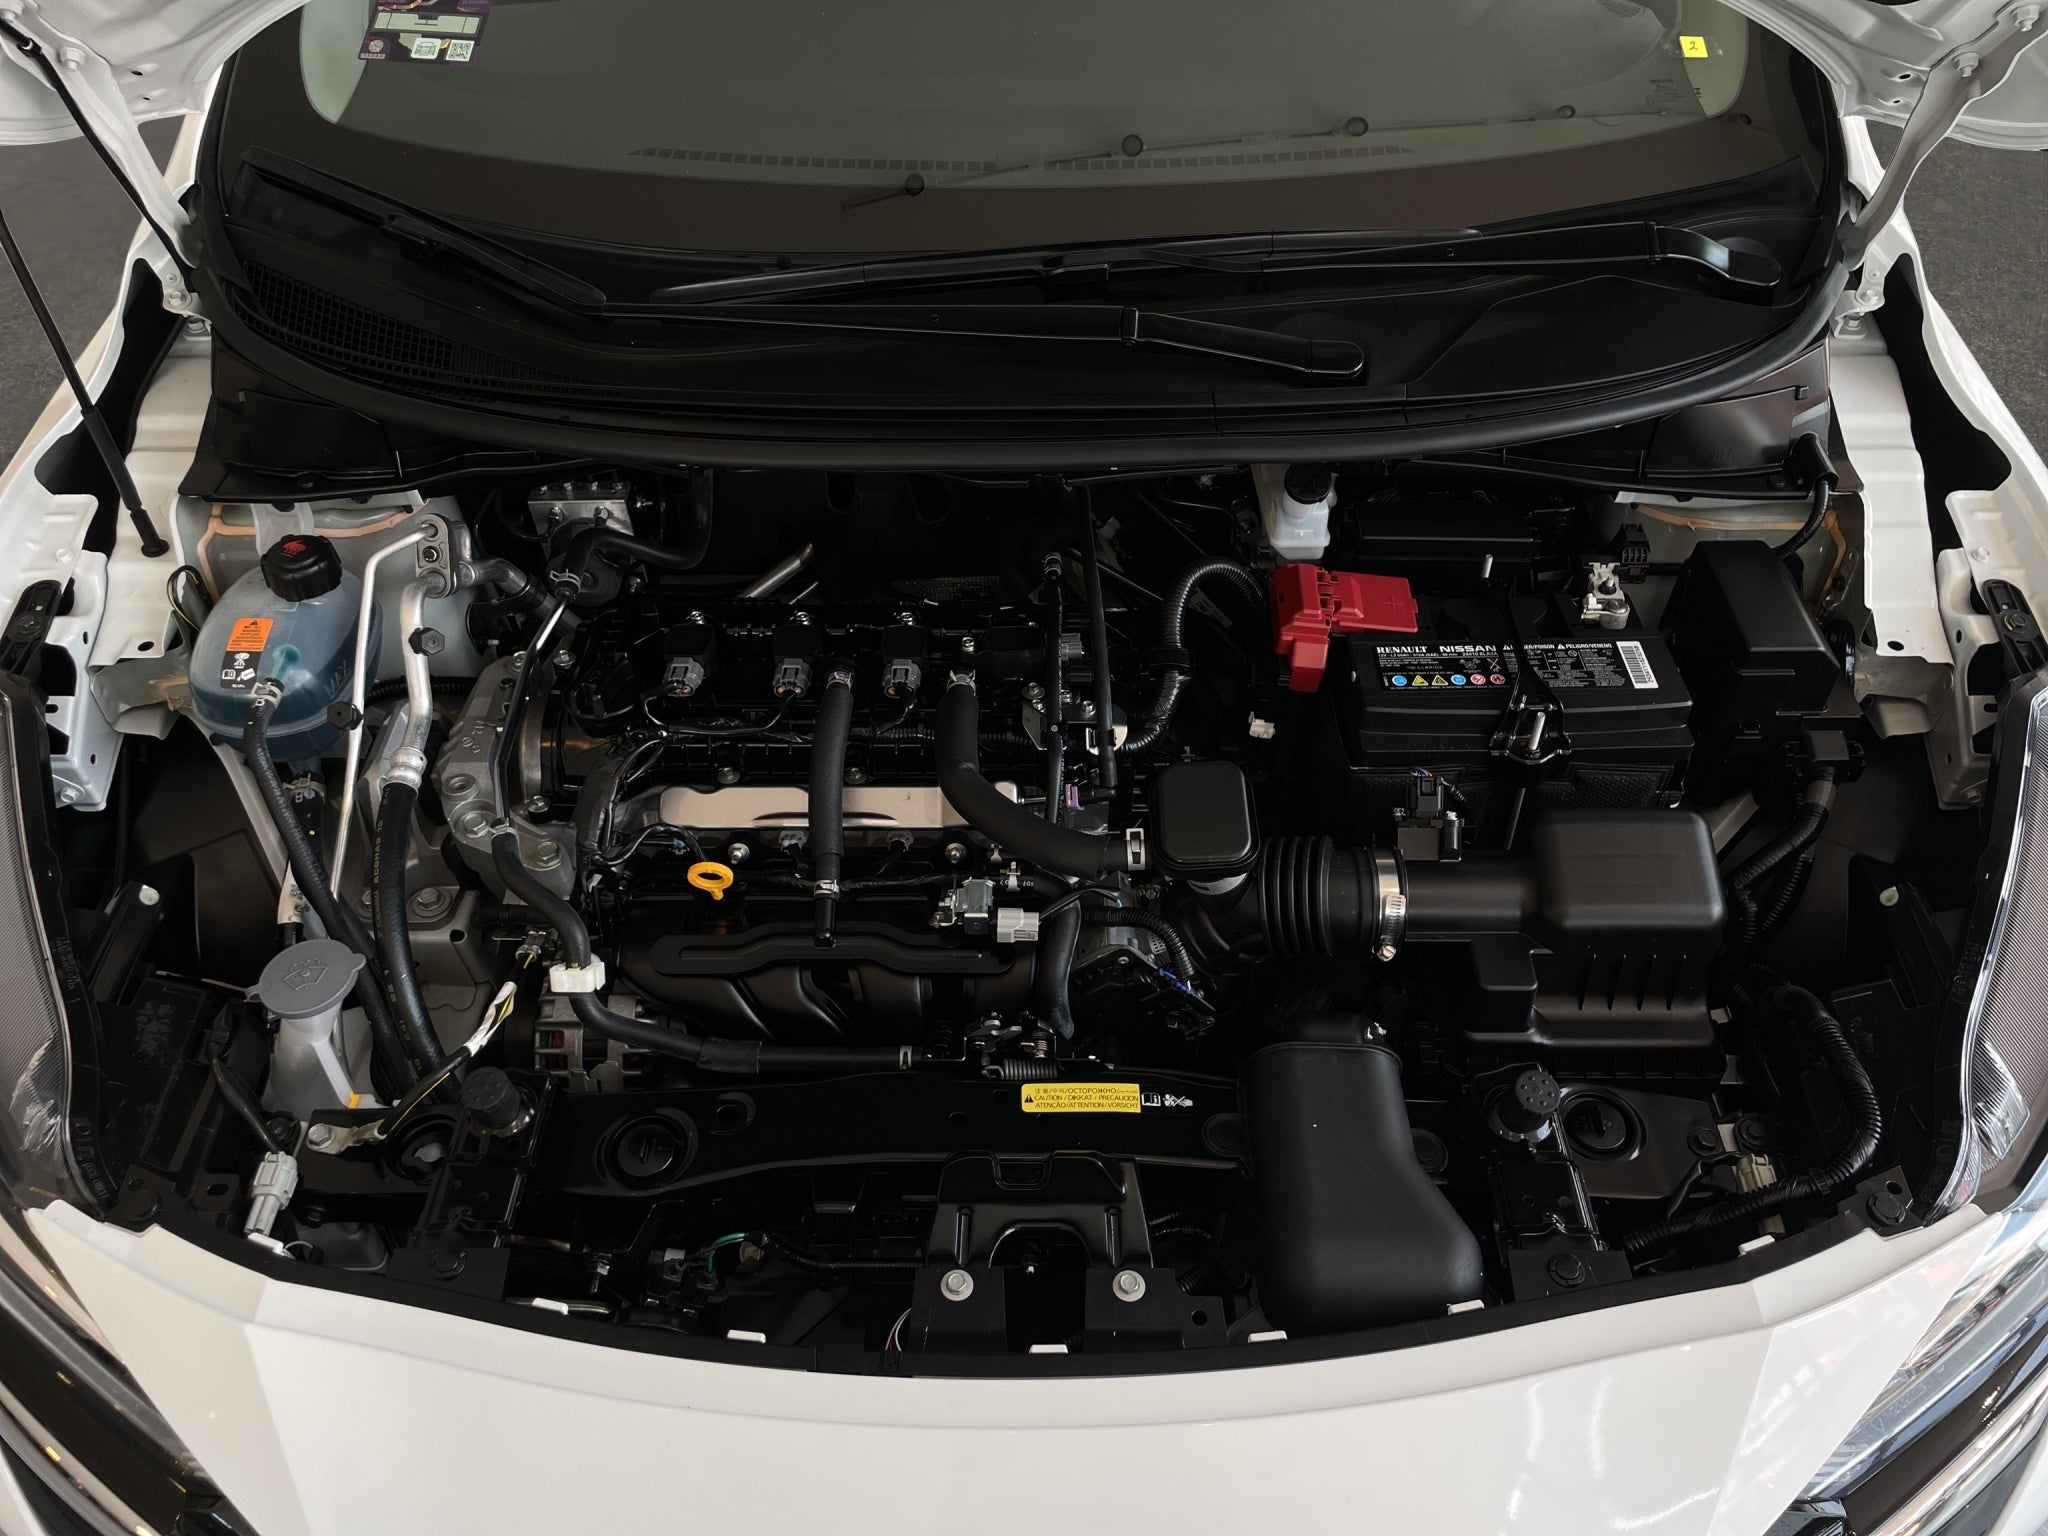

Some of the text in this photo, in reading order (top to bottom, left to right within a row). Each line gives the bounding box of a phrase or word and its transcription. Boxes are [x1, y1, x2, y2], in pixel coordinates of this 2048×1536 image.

[1690, 41, 1698, 50] 2
[1439, 645, 1497, 653] NISSAN
[324, 659, 351, 700] MAX
